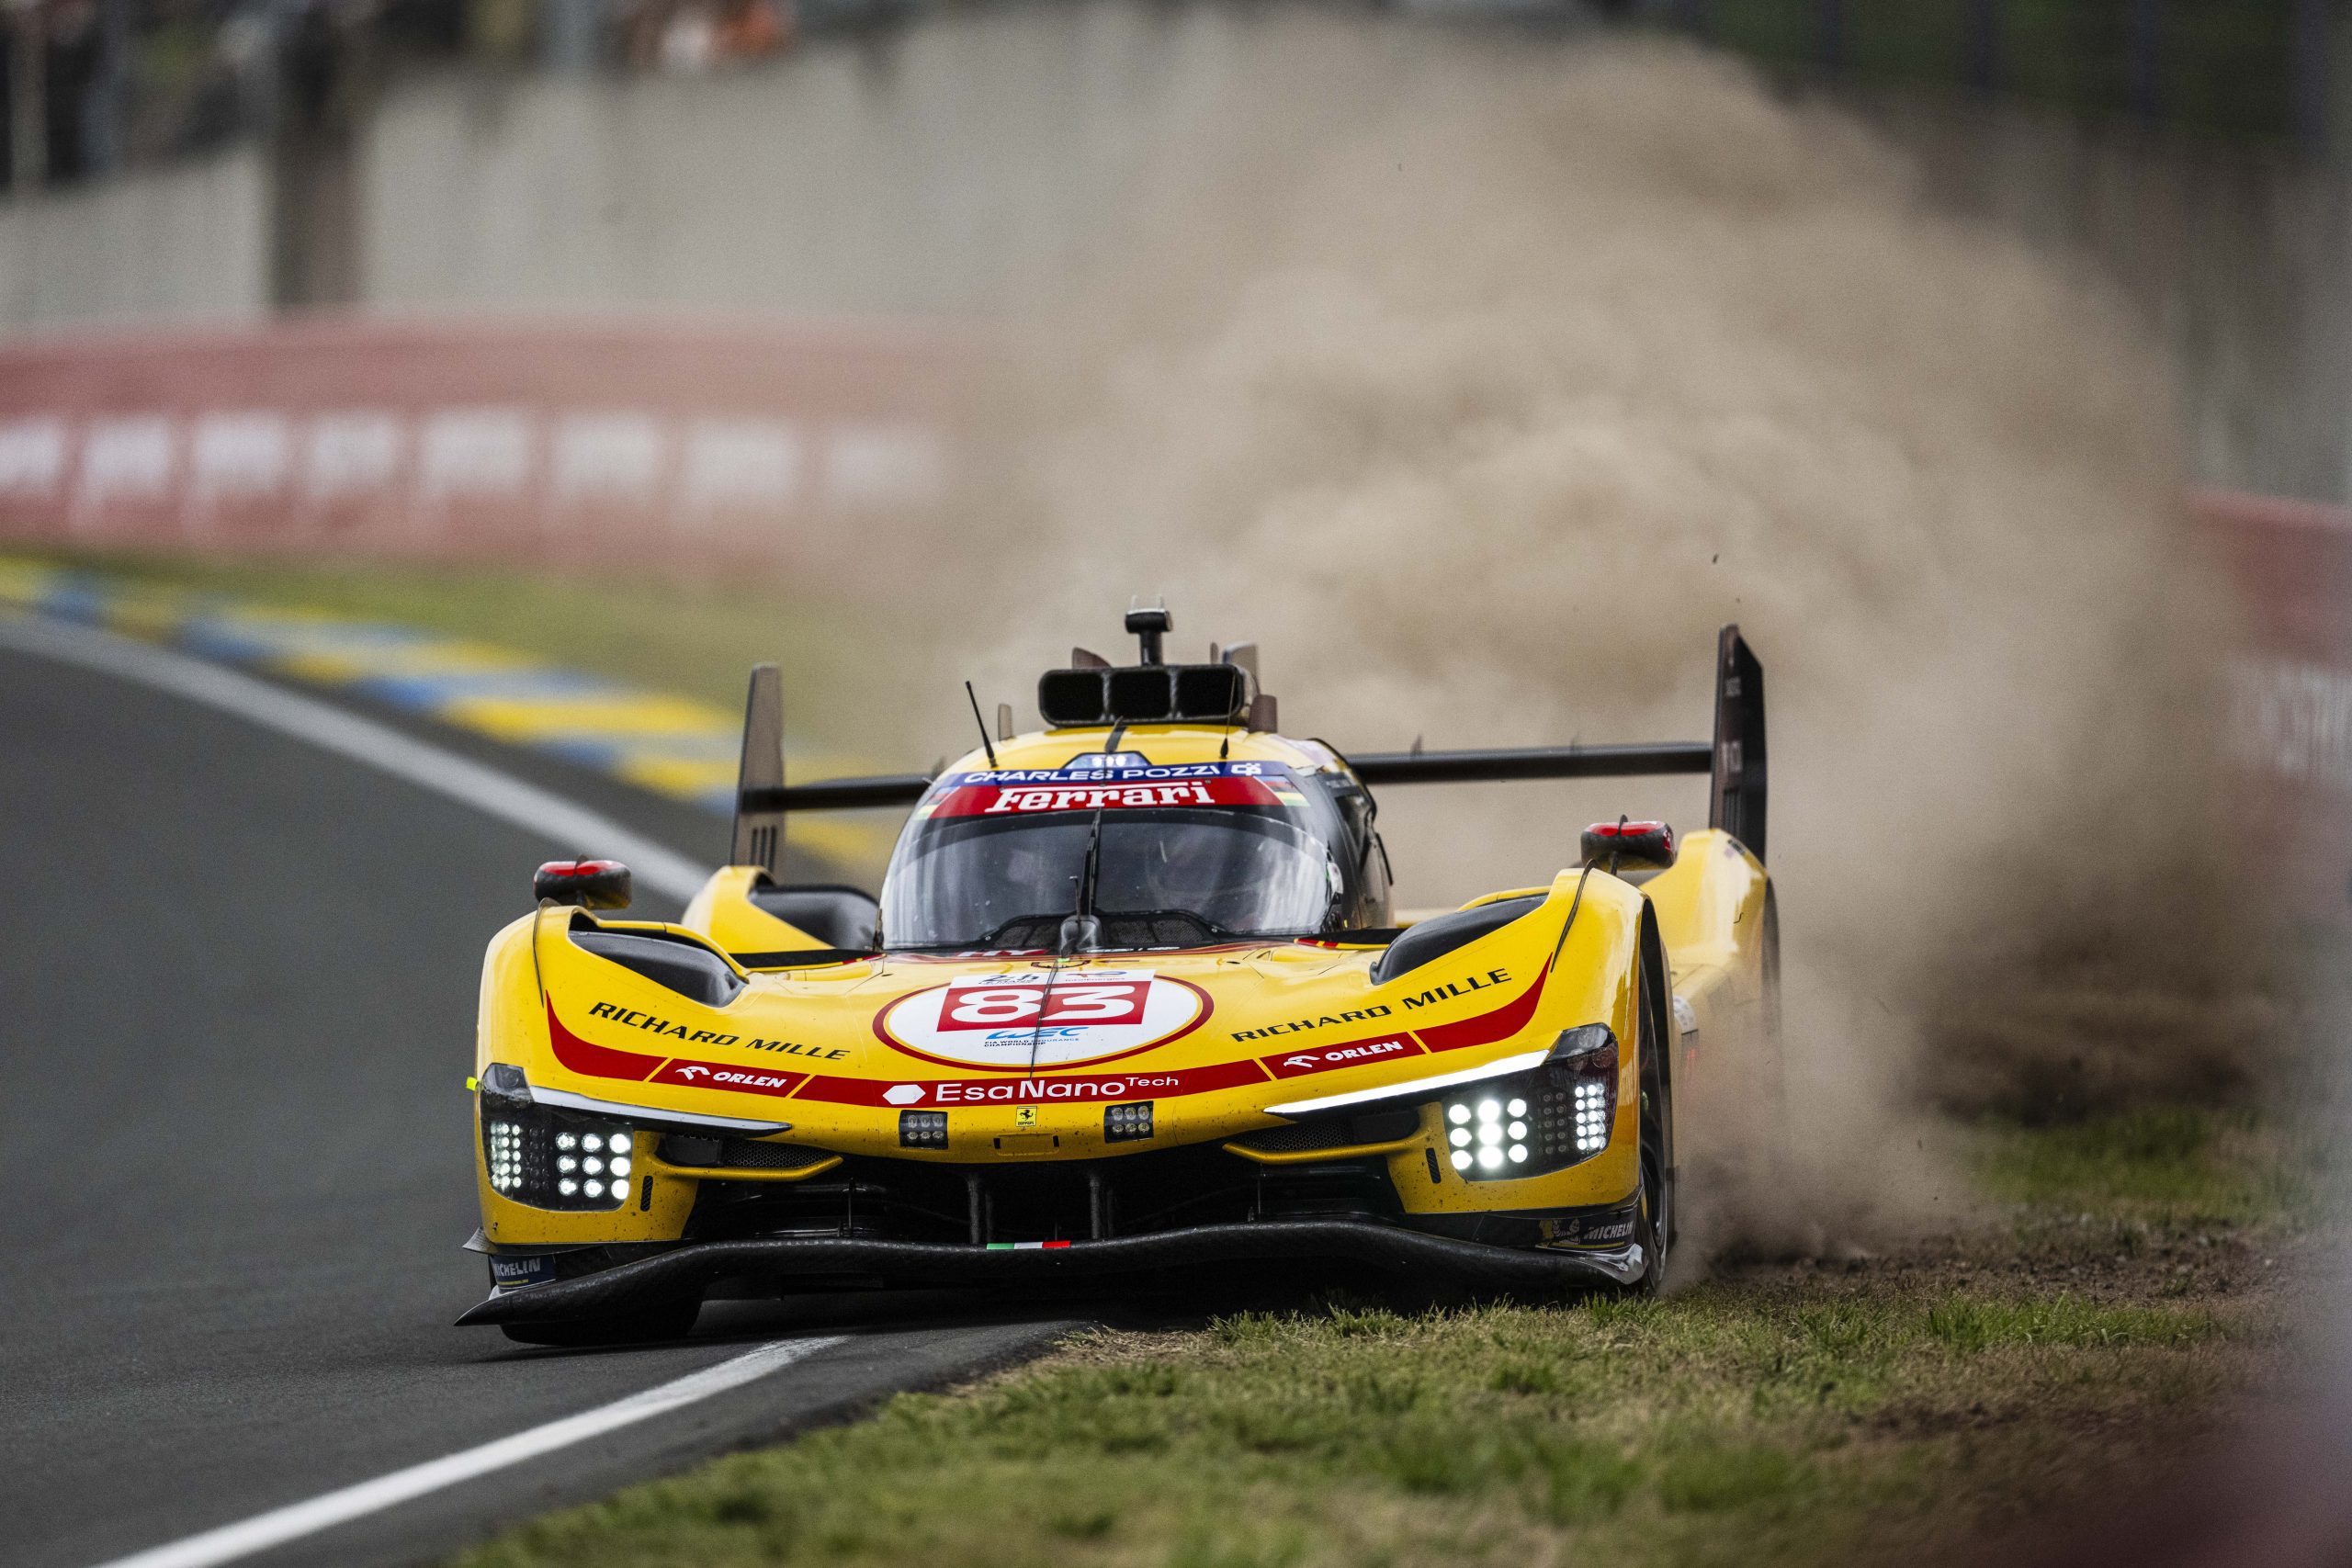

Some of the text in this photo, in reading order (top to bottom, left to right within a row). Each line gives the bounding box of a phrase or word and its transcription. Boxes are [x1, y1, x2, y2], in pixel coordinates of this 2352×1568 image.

[964, 768, 1114, 784] CHARLES
[1122, 766, 1221, 780] POZZI
[984, 781, 1216, 813] Ferrari
[950, 985, 1136, 1023] 83
[1230, 967, 1512, 1043] RICHARD MILLE
[588, 1001, 851, 1060] RICHARD MILLE
[986, 1026, 1090, 1040] WEC
[1325, 1040, 1404, 1062] ORLEN
[712, 1071, 787, 1089] ORLEN
[1583, 1220, 1634, 1240] MICHELIN
